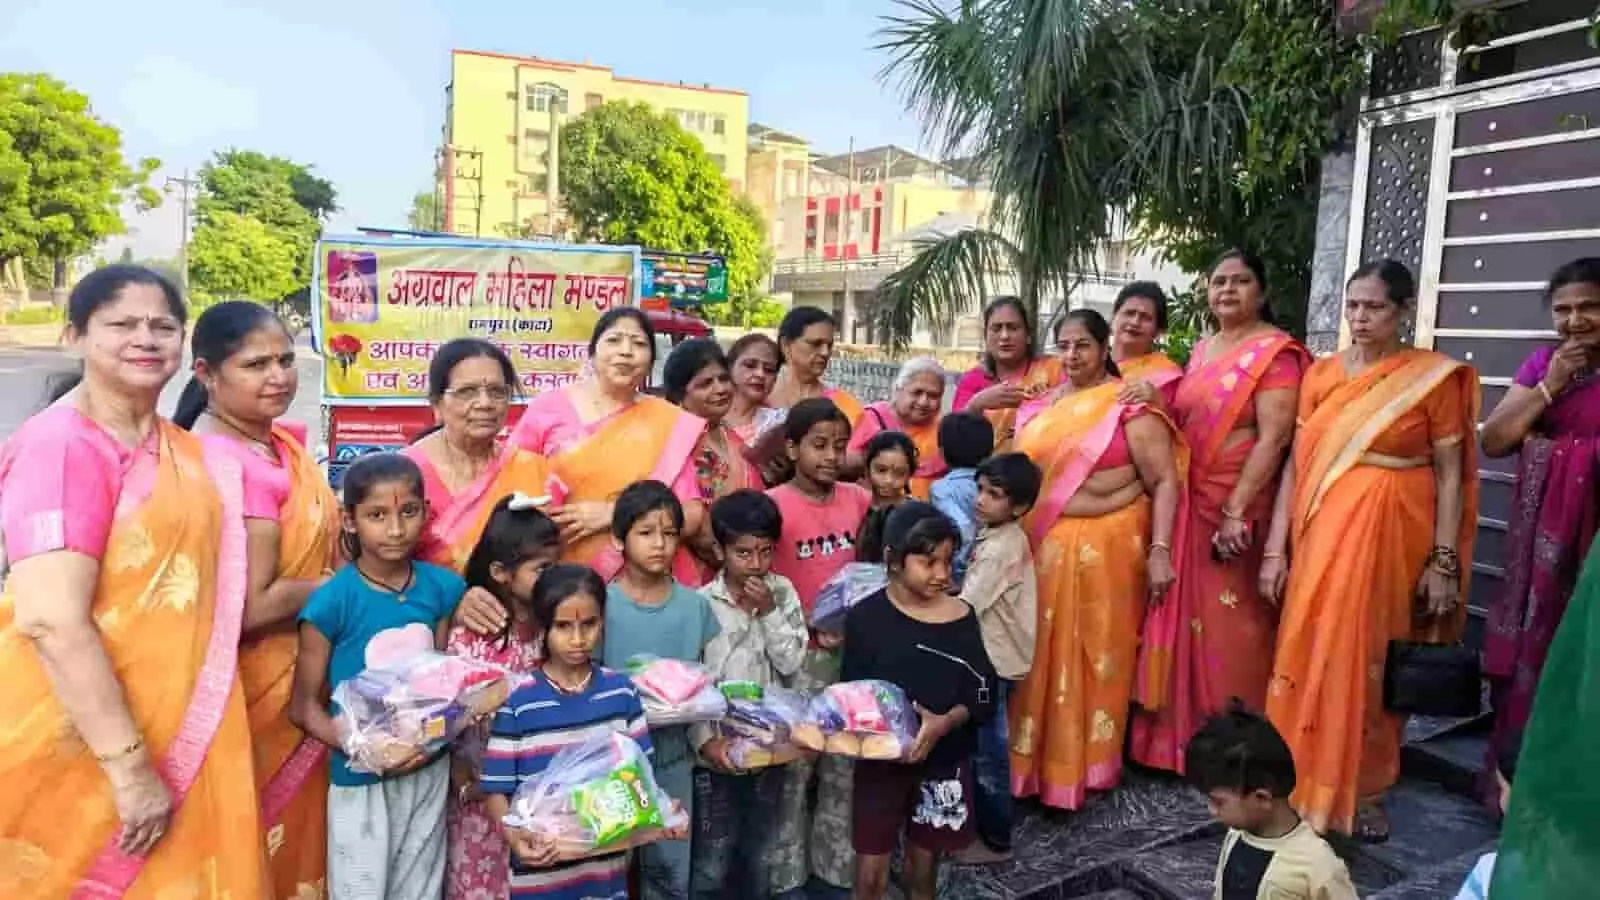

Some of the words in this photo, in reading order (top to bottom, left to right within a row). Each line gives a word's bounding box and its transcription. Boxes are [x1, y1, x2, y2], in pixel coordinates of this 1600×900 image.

[387, 269, 478, 308] अग्रवाल
[486, 256, 556, 312] महिला
[564, 273, 629, 313] मण्डल
